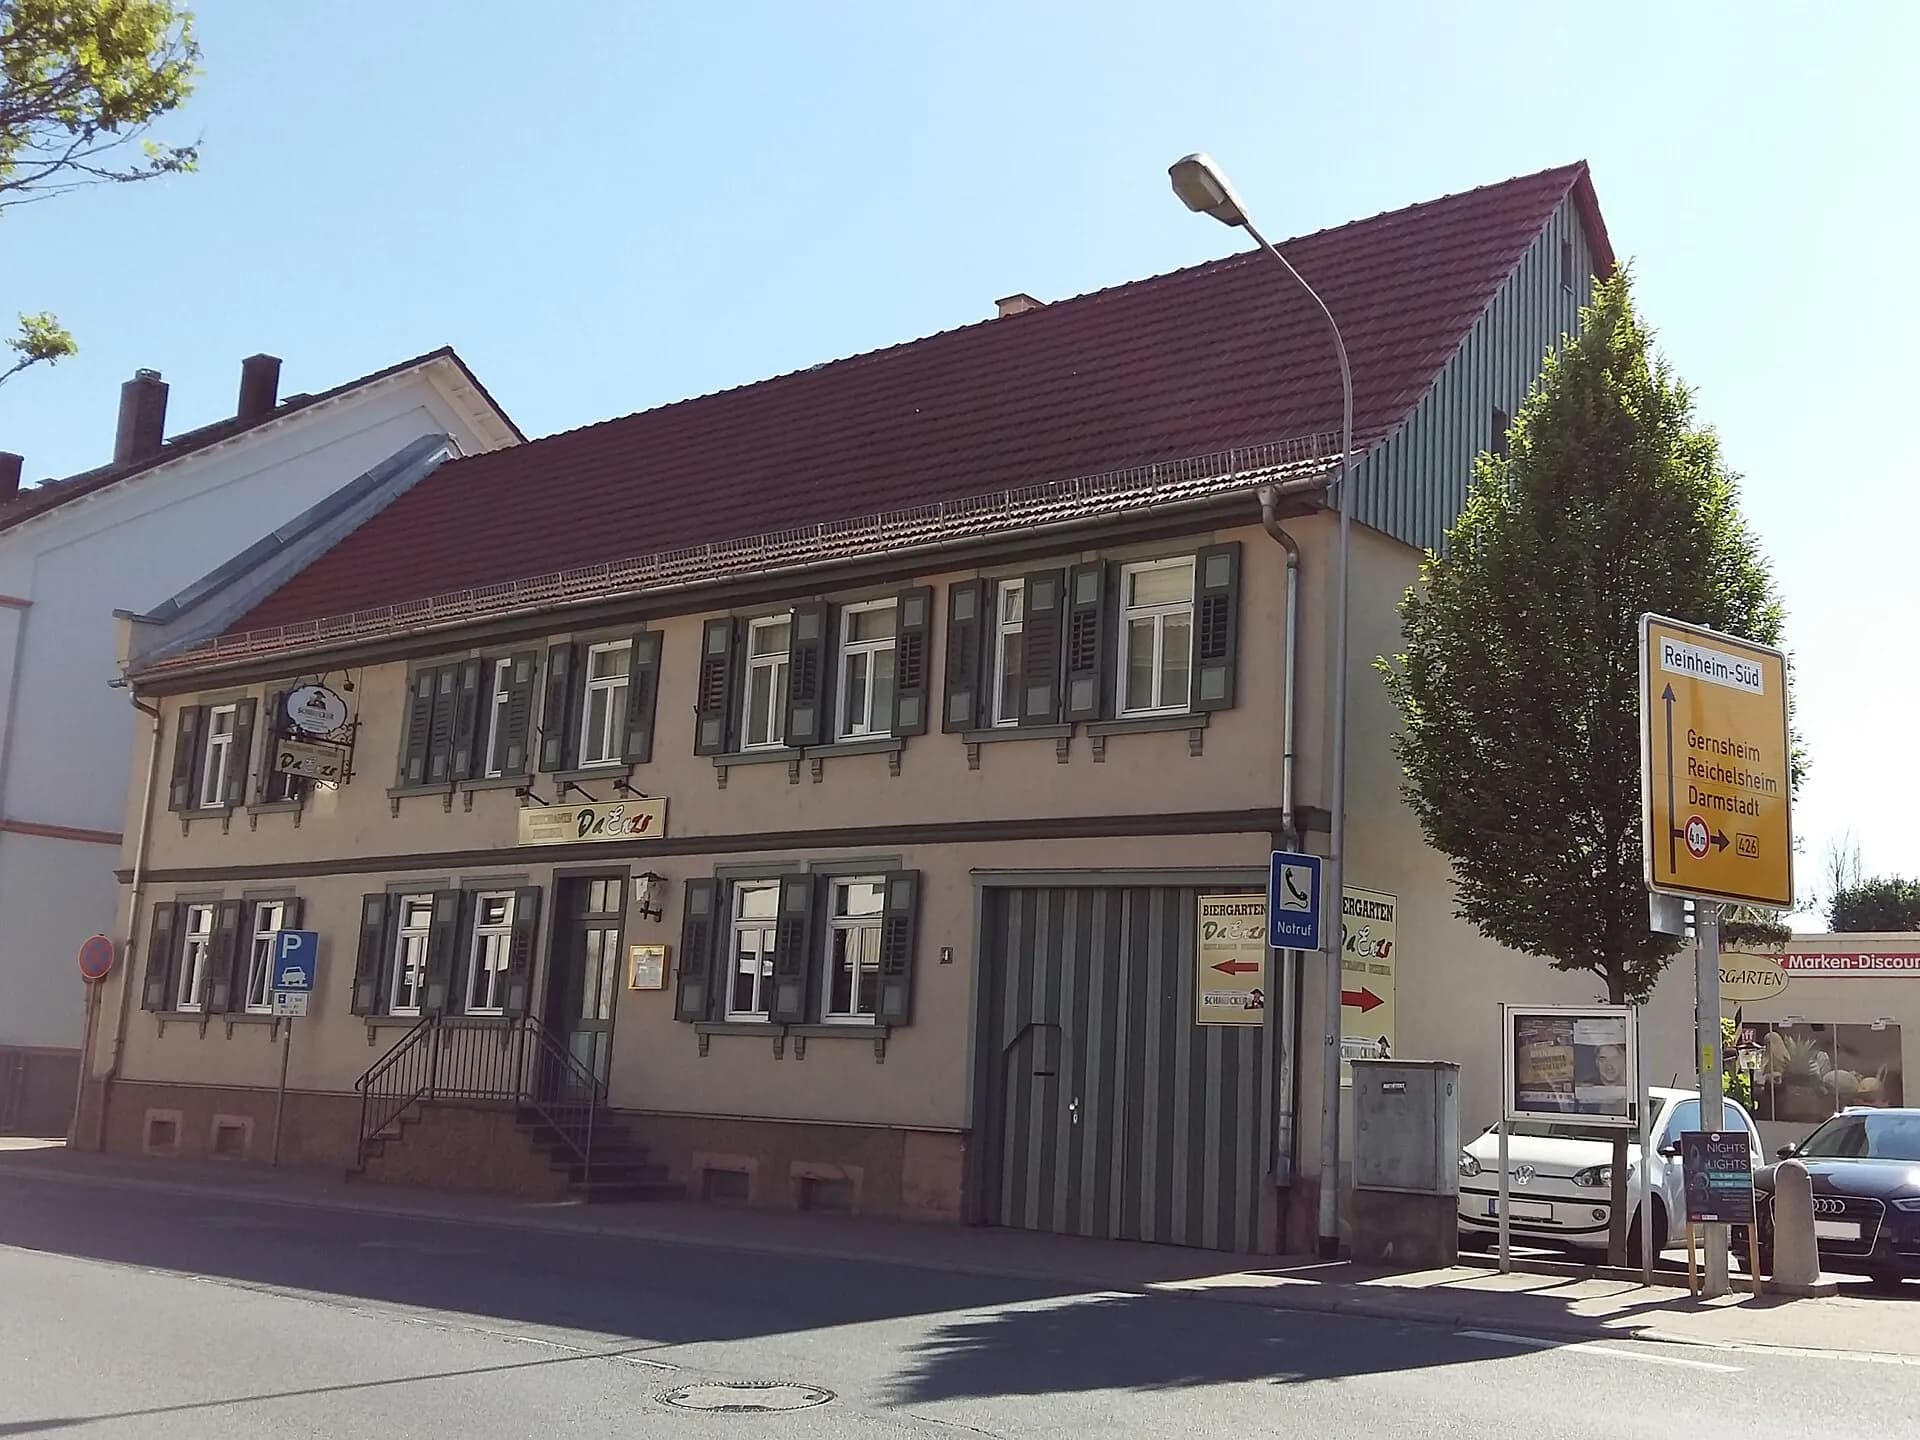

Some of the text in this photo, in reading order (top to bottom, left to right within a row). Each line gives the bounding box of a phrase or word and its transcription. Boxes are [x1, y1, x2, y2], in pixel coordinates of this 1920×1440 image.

[1664, 644, 1760, 688] Reinheim-Süd
[1687, 728, 1760, 762] Gernsheim
[279, 752, 303, 770] Da
[1687, 756, 1777, 793] Reichelsheim
[1688, 785, 1760, 817] Darmstadt
[577, 808, 606, 839] Da
[606, 805, 653, 837] Enzo
[1738, 836, 1757, 855] 426
[1203, 903, 1265, 917] BIERGARTEN
[1343, 897, 1393, 922] ERGARTEN
[1203, 920, 1265, 941] Da Enzo
[1277, 920, 1313, 937] Notruf
[281, 933, 303, 959] P
[1357, 925, 1393, 959] Enzo
[1719, 968, 1784, 986] RGARTEN
[1706, 1143, 1747, 1153] NIGHTS
